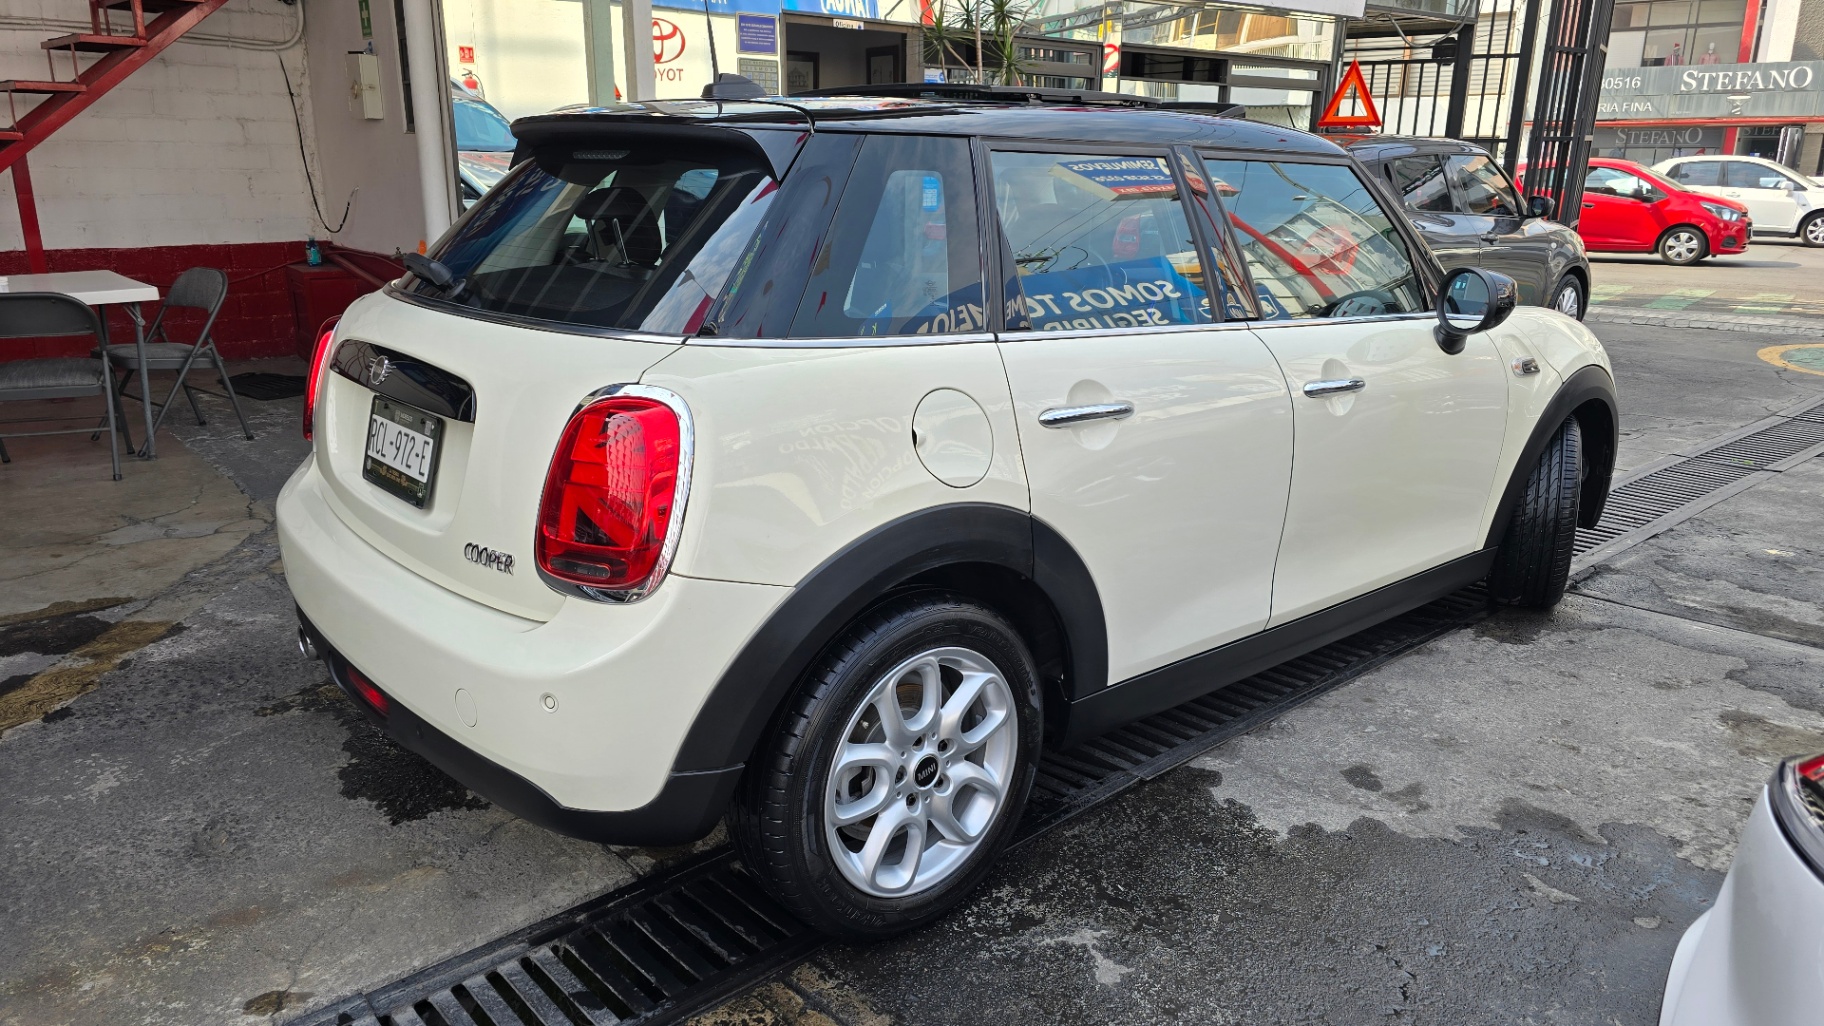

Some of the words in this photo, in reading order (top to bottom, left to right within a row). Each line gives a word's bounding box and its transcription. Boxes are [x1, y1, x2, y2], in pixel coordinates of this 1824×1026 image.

[1681, 66, 1813, 91] STEFANO
[1622, 102, 1653, 113] FINA
[1615, 127, 1703, 145] STEFANO
[368, 416, 430, 477] RCL-972-E
[464, 542, 516, 577] COOPER
[917, 762, 937, 781] MINI
